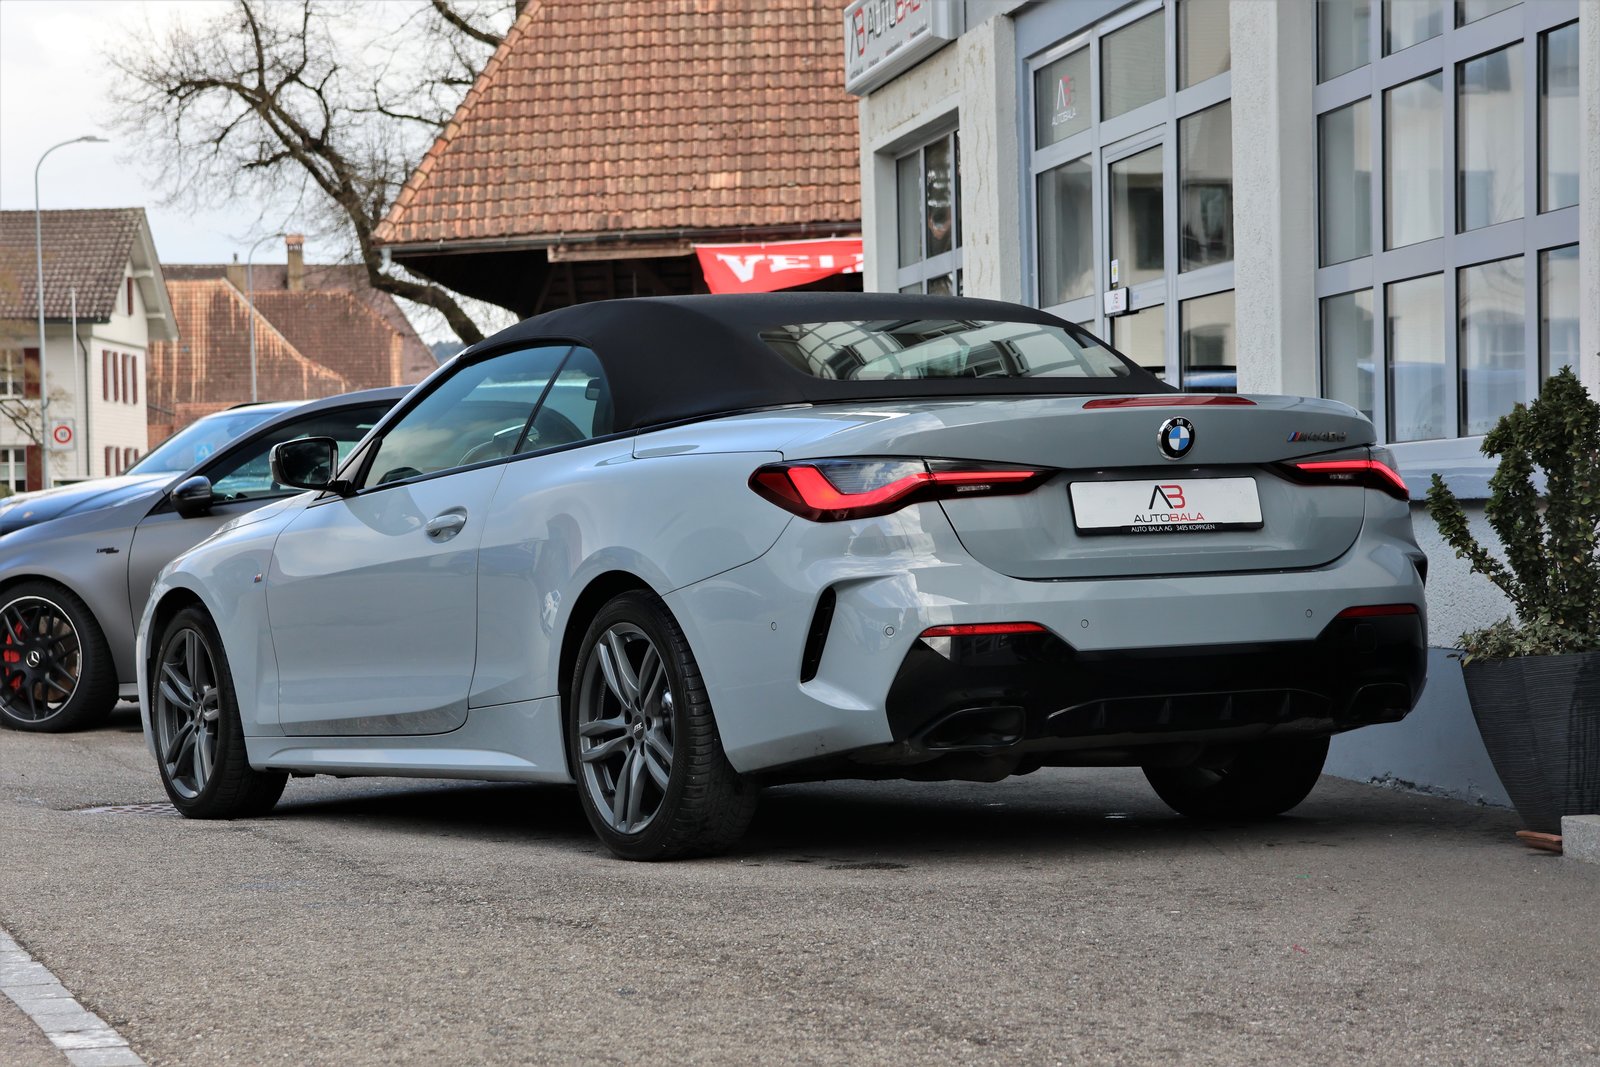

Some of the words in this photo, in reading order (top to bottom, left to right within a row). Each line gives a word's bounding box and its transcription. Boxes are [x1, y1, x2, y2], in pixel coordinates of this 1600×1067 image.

[867, 0, 928, 46] AUTOBA
[1166, 418, 1193, 432] BMW
[1133, 512, 1205, 523] AUTOBALA
